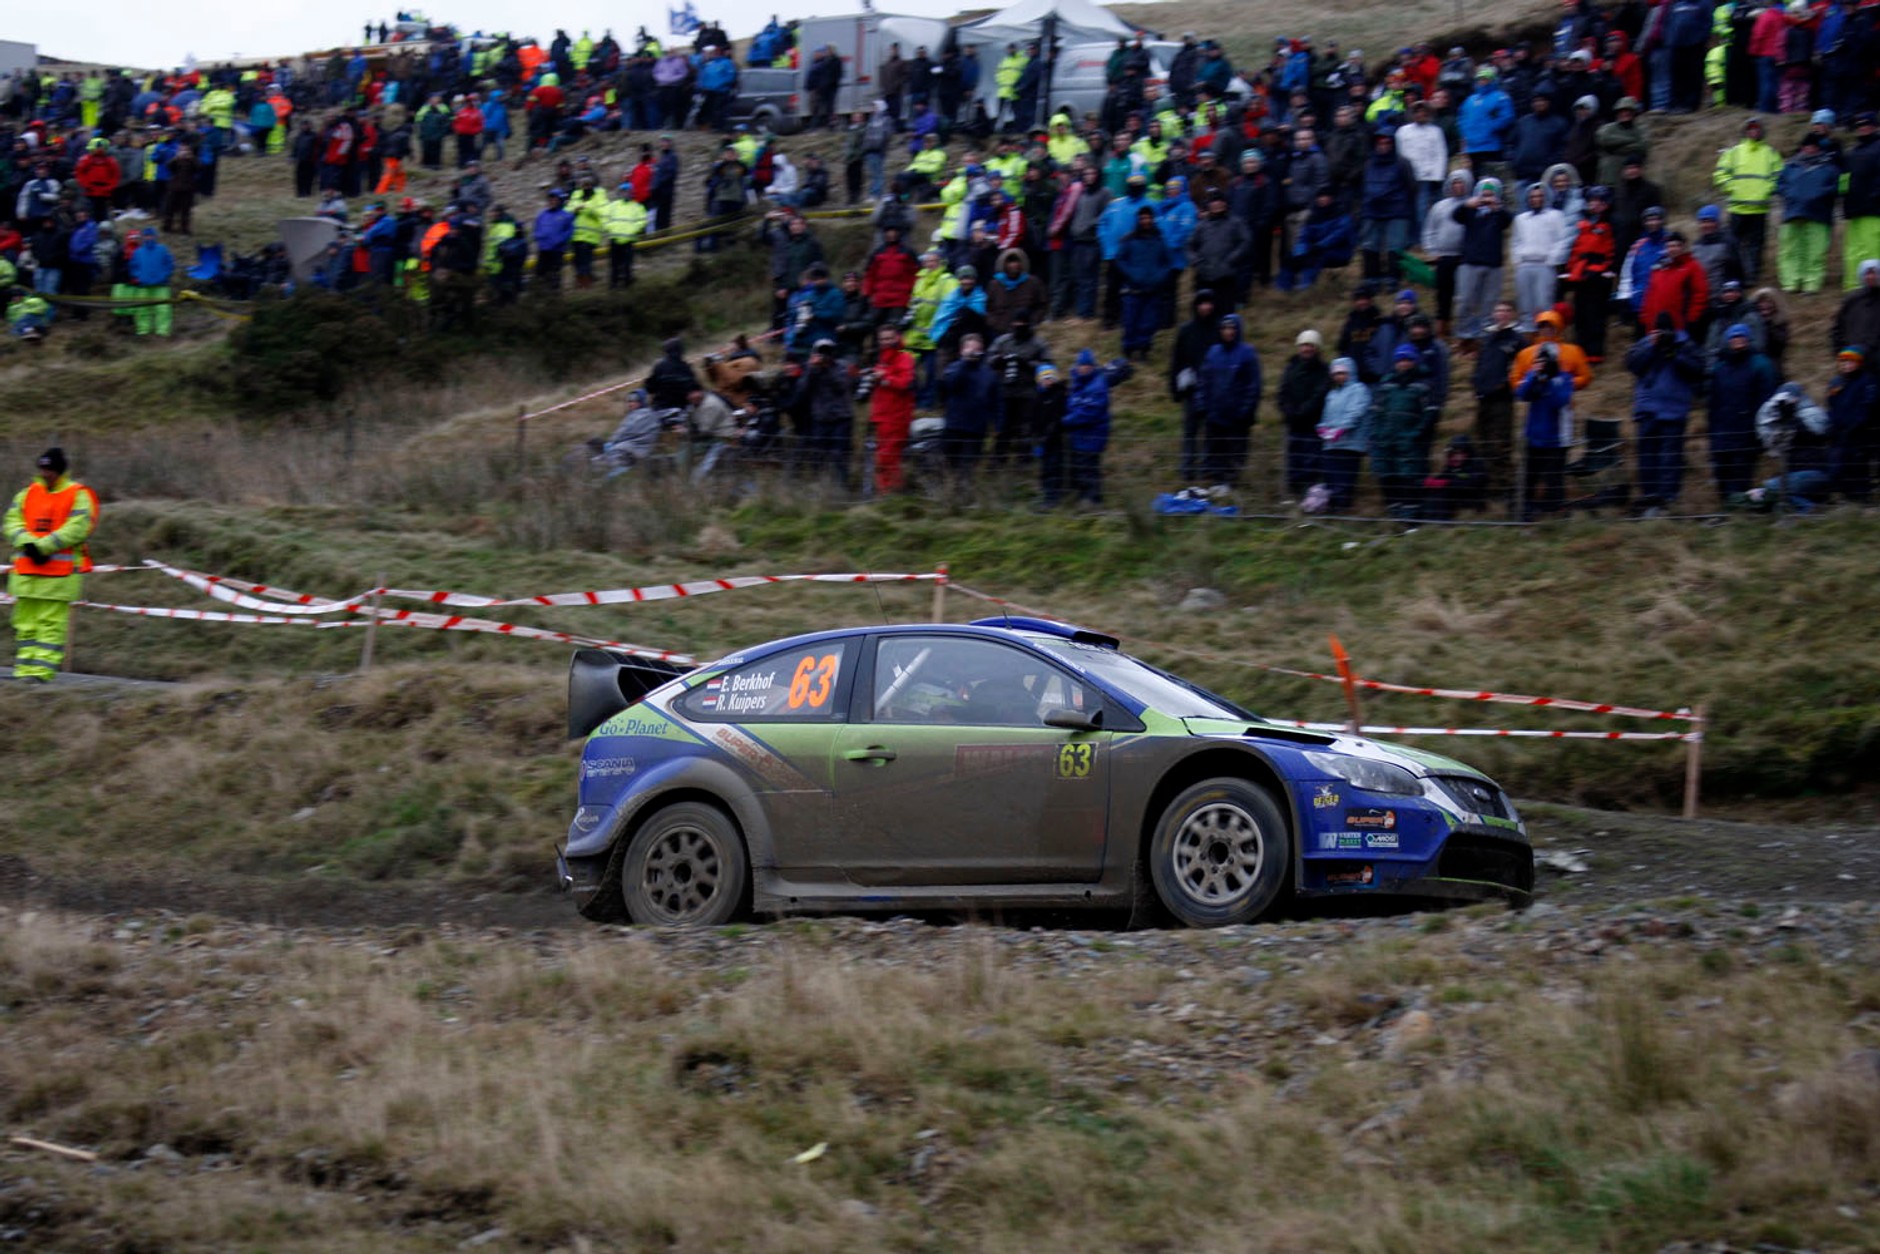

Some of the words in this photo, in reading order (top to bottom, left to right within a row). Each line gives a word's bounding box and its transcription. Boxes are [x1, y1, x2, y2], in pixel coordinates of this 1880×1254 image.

[720, 676, 730, 692] E.
[732, 672, 775, 692] Berkhof
[788, 654, 836, 709] 63
[715, 696, 726, 712] R.
[728, 693, 767, 713] Kuipers
[1059, 743, 1091, 777] 63
